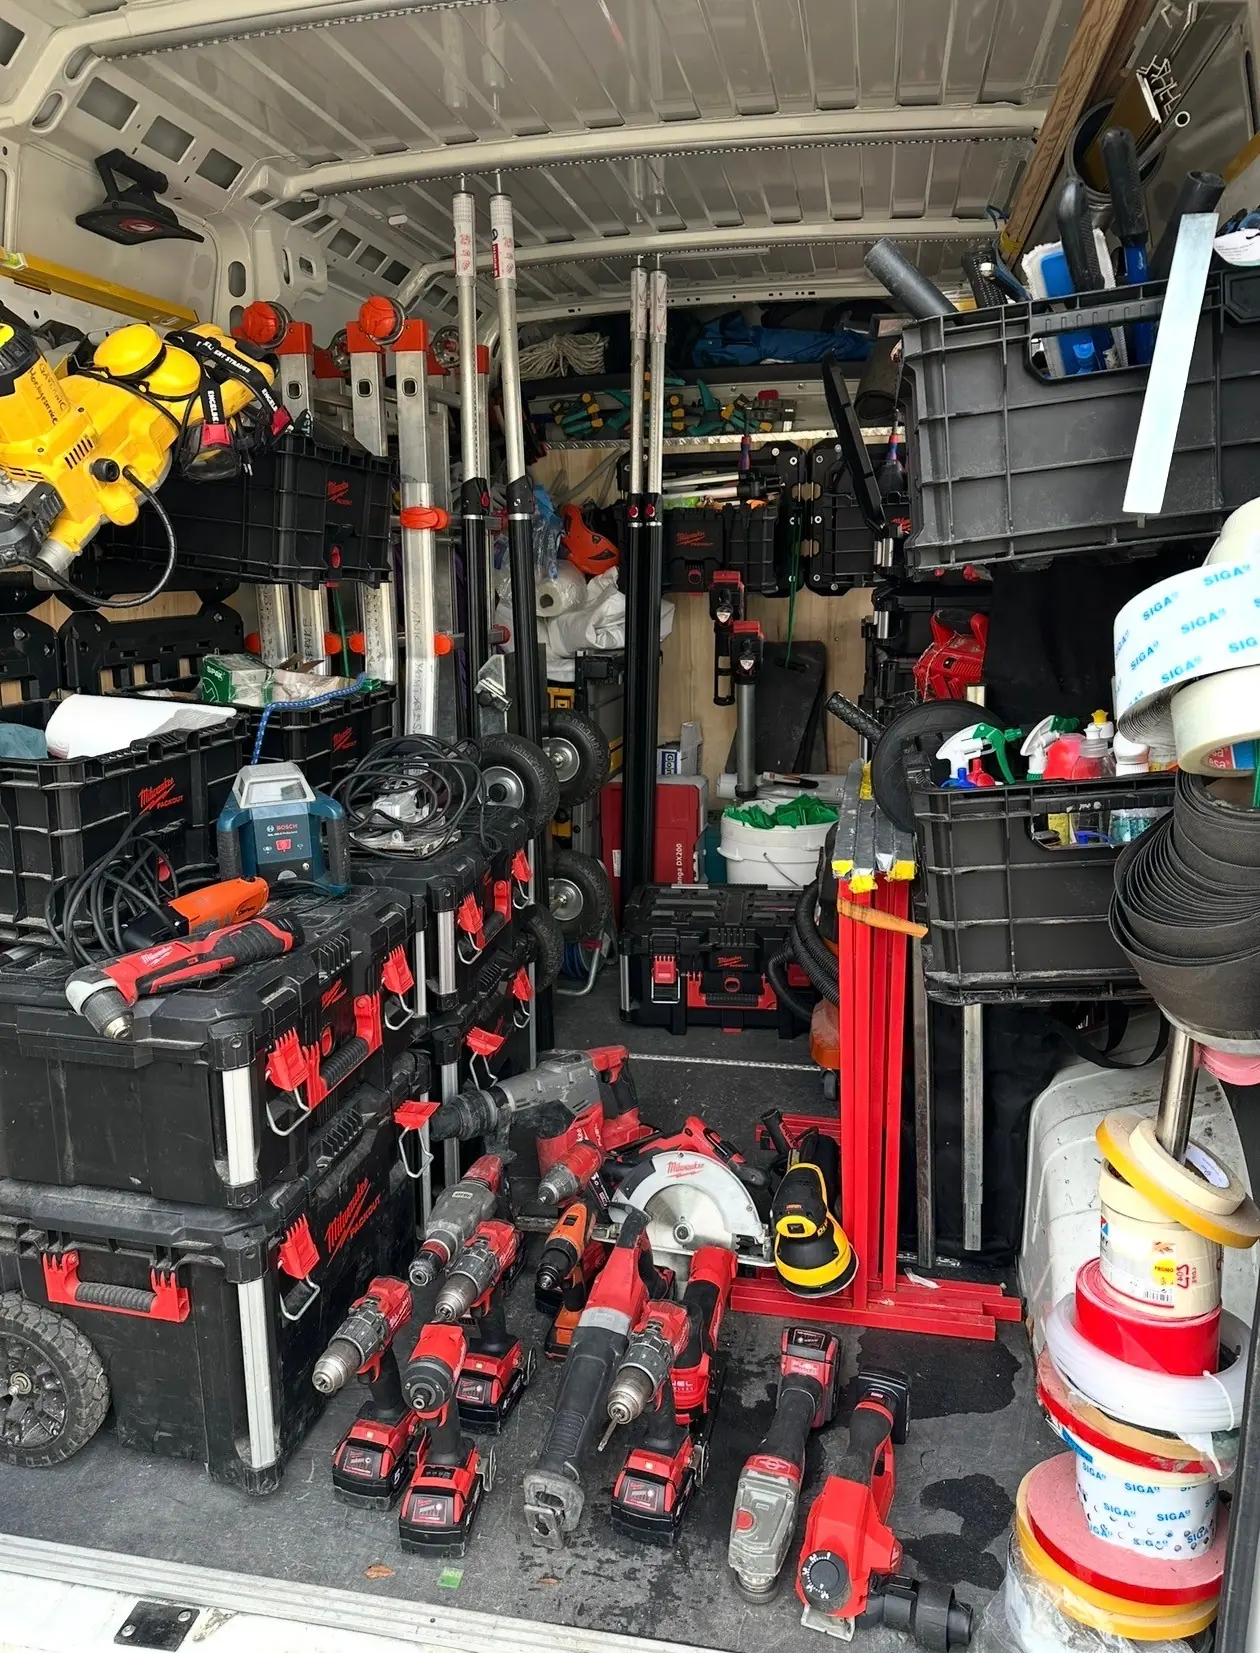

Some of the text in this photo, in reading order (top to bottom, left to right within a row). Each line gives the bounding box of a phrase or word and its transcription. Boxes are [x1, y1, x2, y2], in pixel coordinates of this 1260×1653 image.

[1228, 637, 1258, 653] SIG
[667, 1161, 705, 1175] Milwaukee
[1124, 1482, 1161, 1494] SIGA
[1157, 1510, 1191, 1522] SIGA
